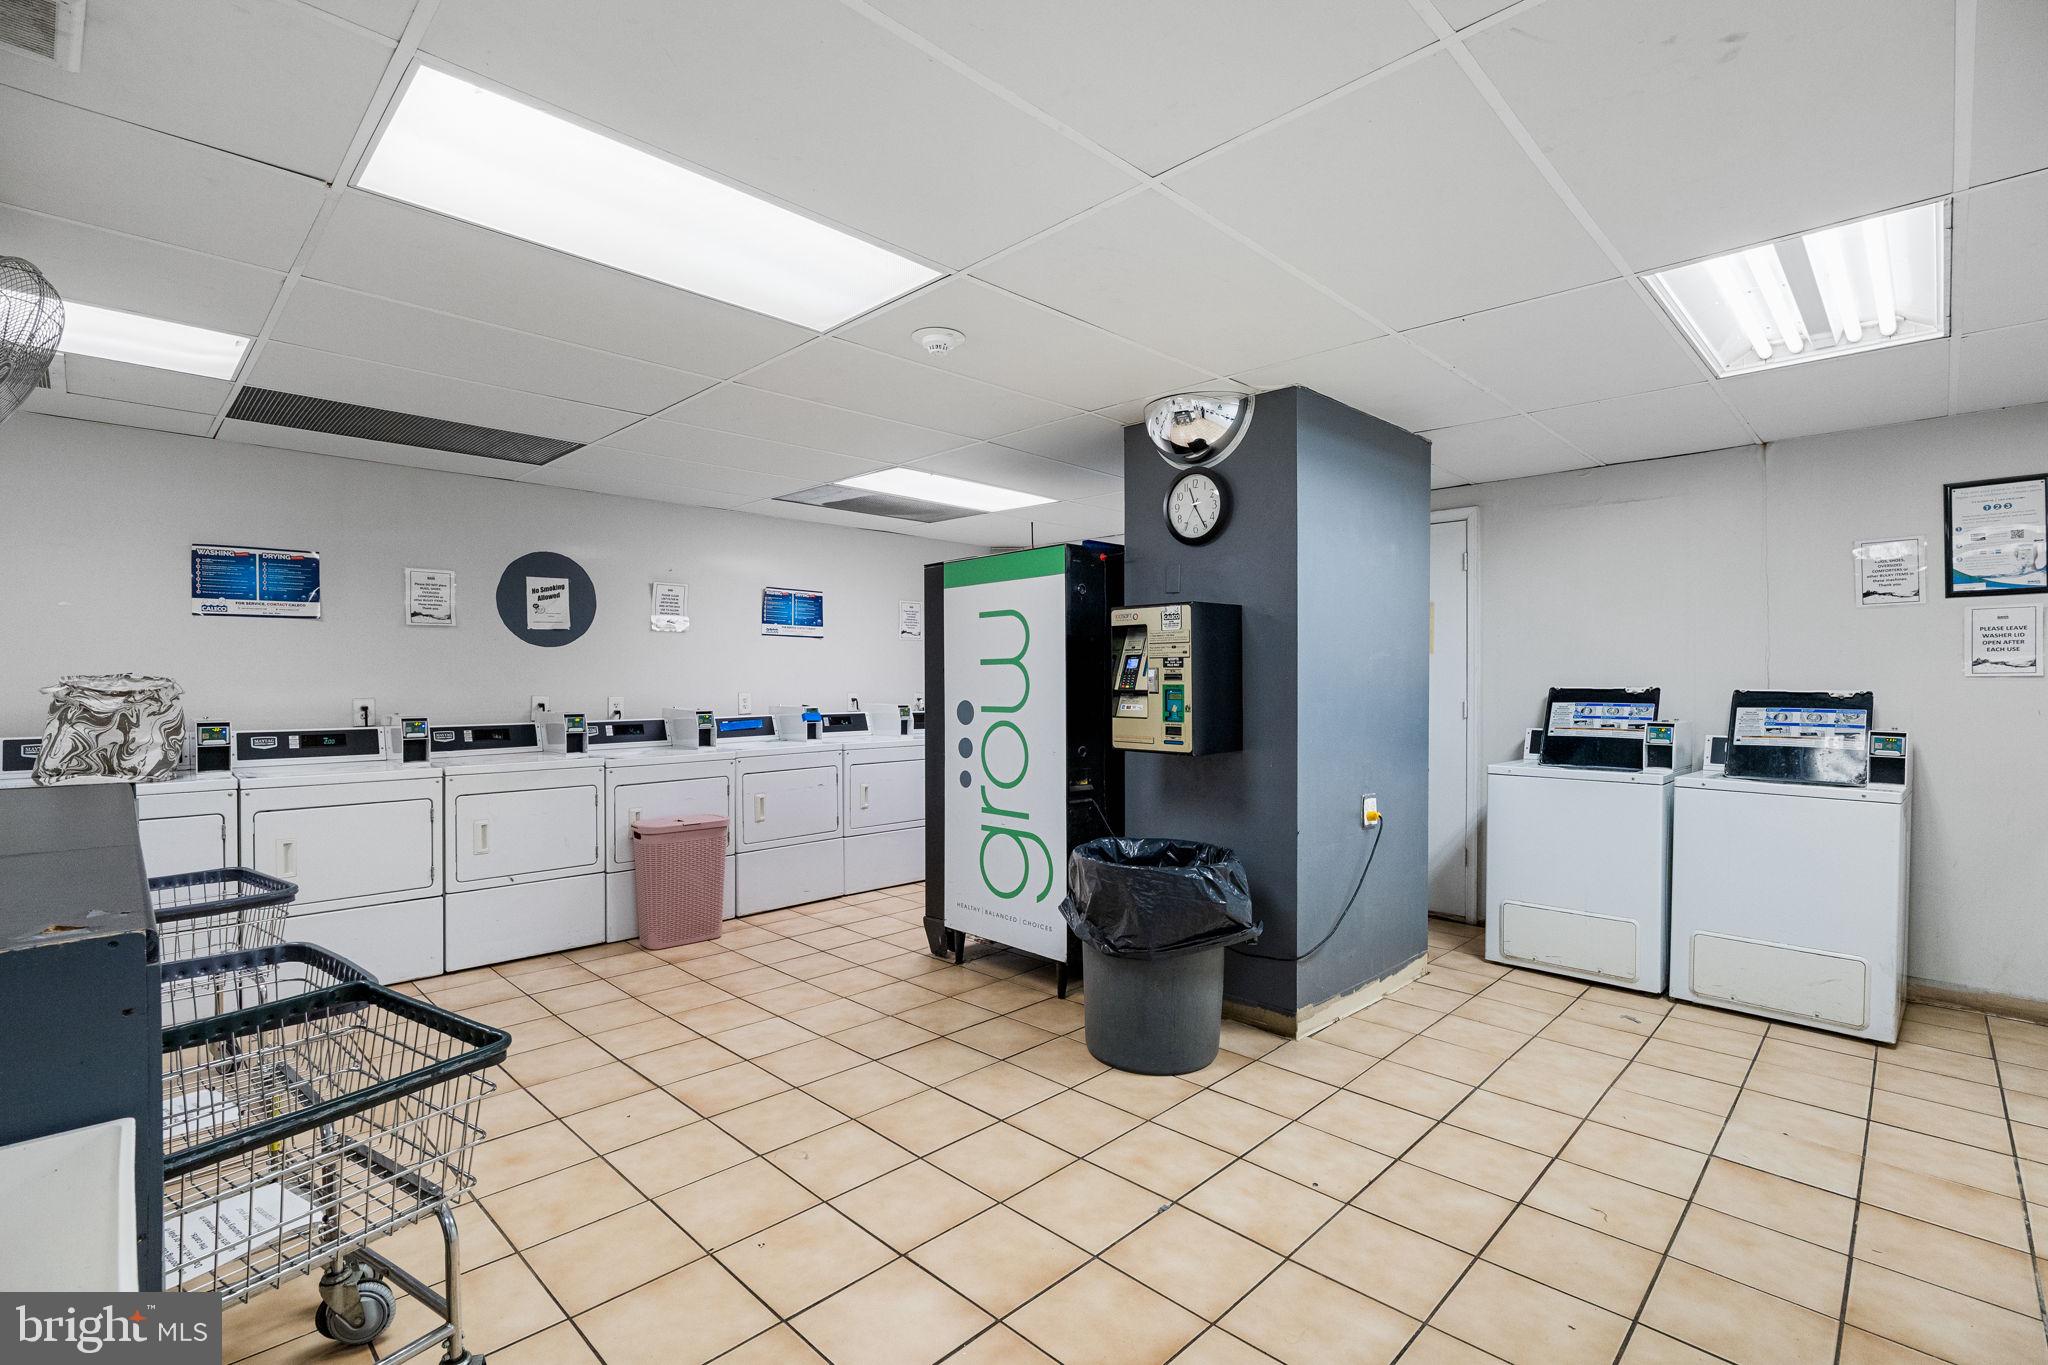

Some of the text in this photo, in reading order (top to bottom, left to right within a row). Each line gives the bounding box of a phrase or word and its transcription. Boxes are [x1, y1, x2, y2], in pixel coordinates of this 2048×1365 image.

[1184, 484, 1188, 492] 11
[1193, 479, 1198, 488] 12
[1177, 492, 1183, 501] 10
[1175, 504, 1180, 513] 9
[1213, 500, 1217, 509] 3
[1178, 515, 1182, 523] 8
[1210, 512, 1215, 520] 4
[1184, 522, 1188, 531] 7
[1193, 524, 1198, 534] 6
[540, 584, 565, 593] Smoking
[538, 592, 560, 601] Allowed
[957, 902, 1052, 932] HEALTHY BALANCED CHOICES
